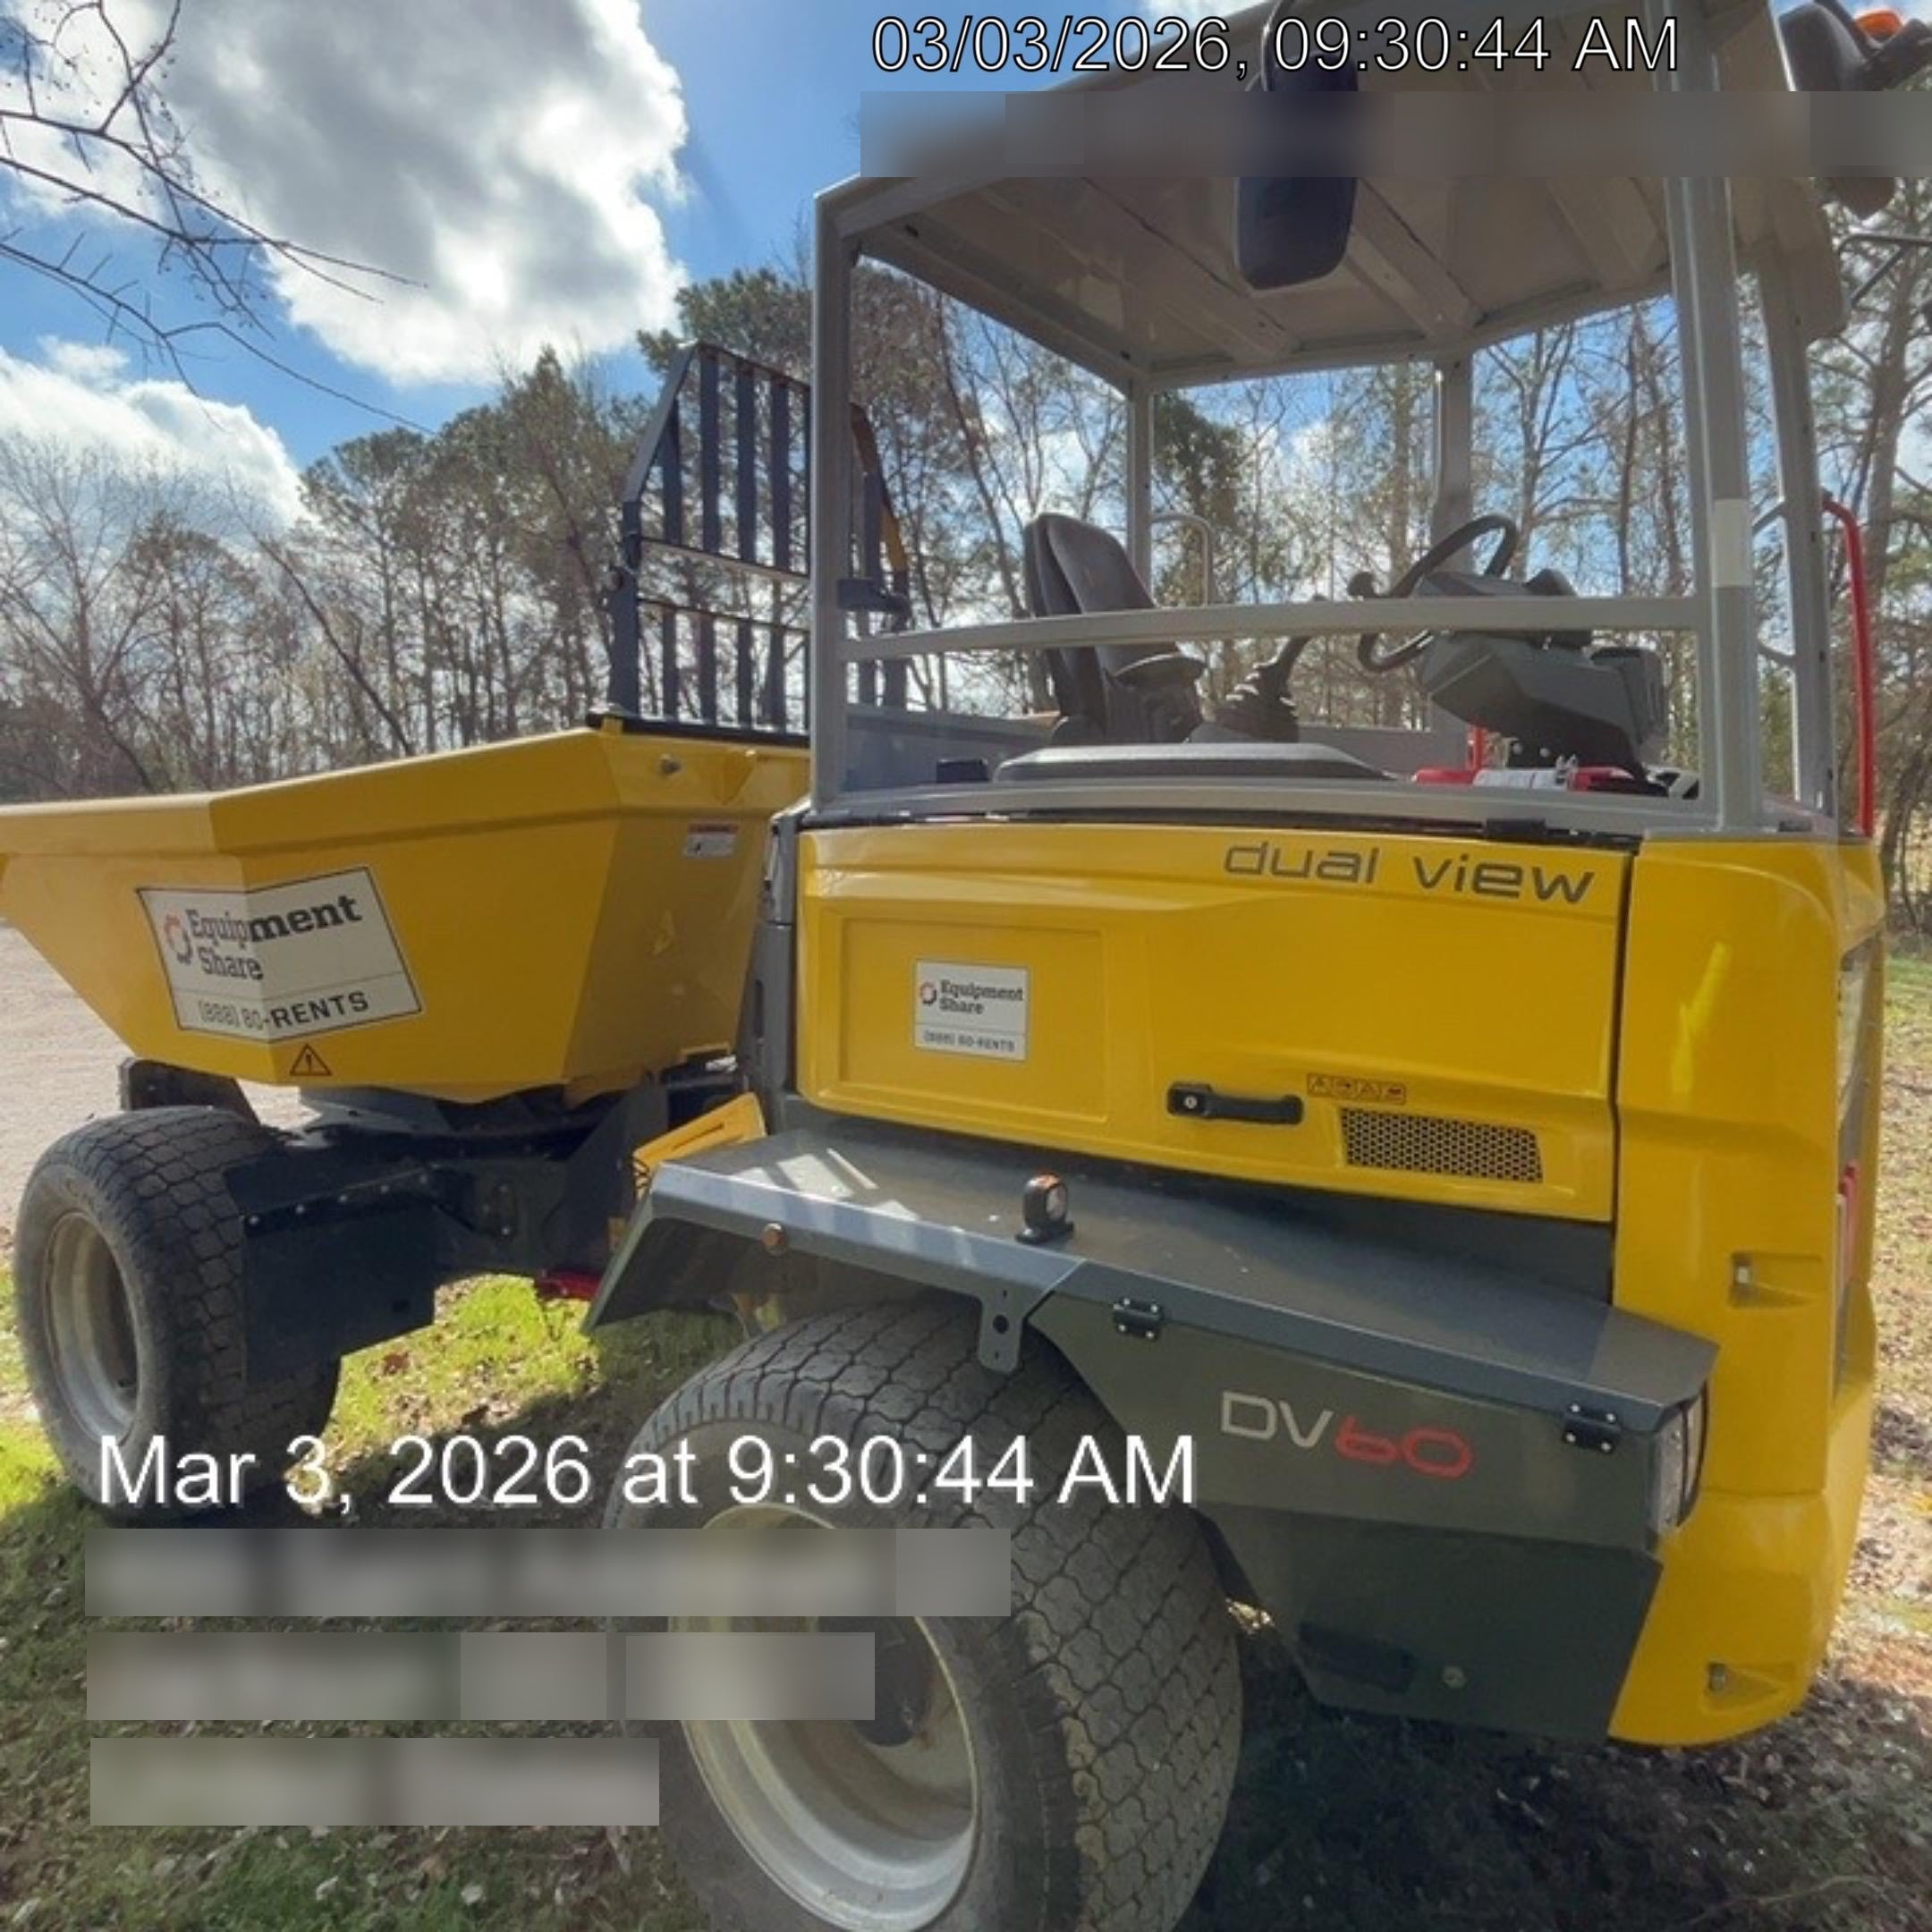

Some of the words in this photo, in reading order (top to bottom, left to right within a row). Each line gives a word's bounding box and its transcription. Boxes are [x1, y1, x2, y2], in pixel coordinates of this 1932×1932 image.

[1224, 841, 1380, 884] dual
[1412, 853, 1595, 903] view
[185, 894, 363, 948] Equipment
[197, 945, 265, 980] Share
[939, 996, 985, 1014] Share
[940, 979, 1024, 1002] Equipment
